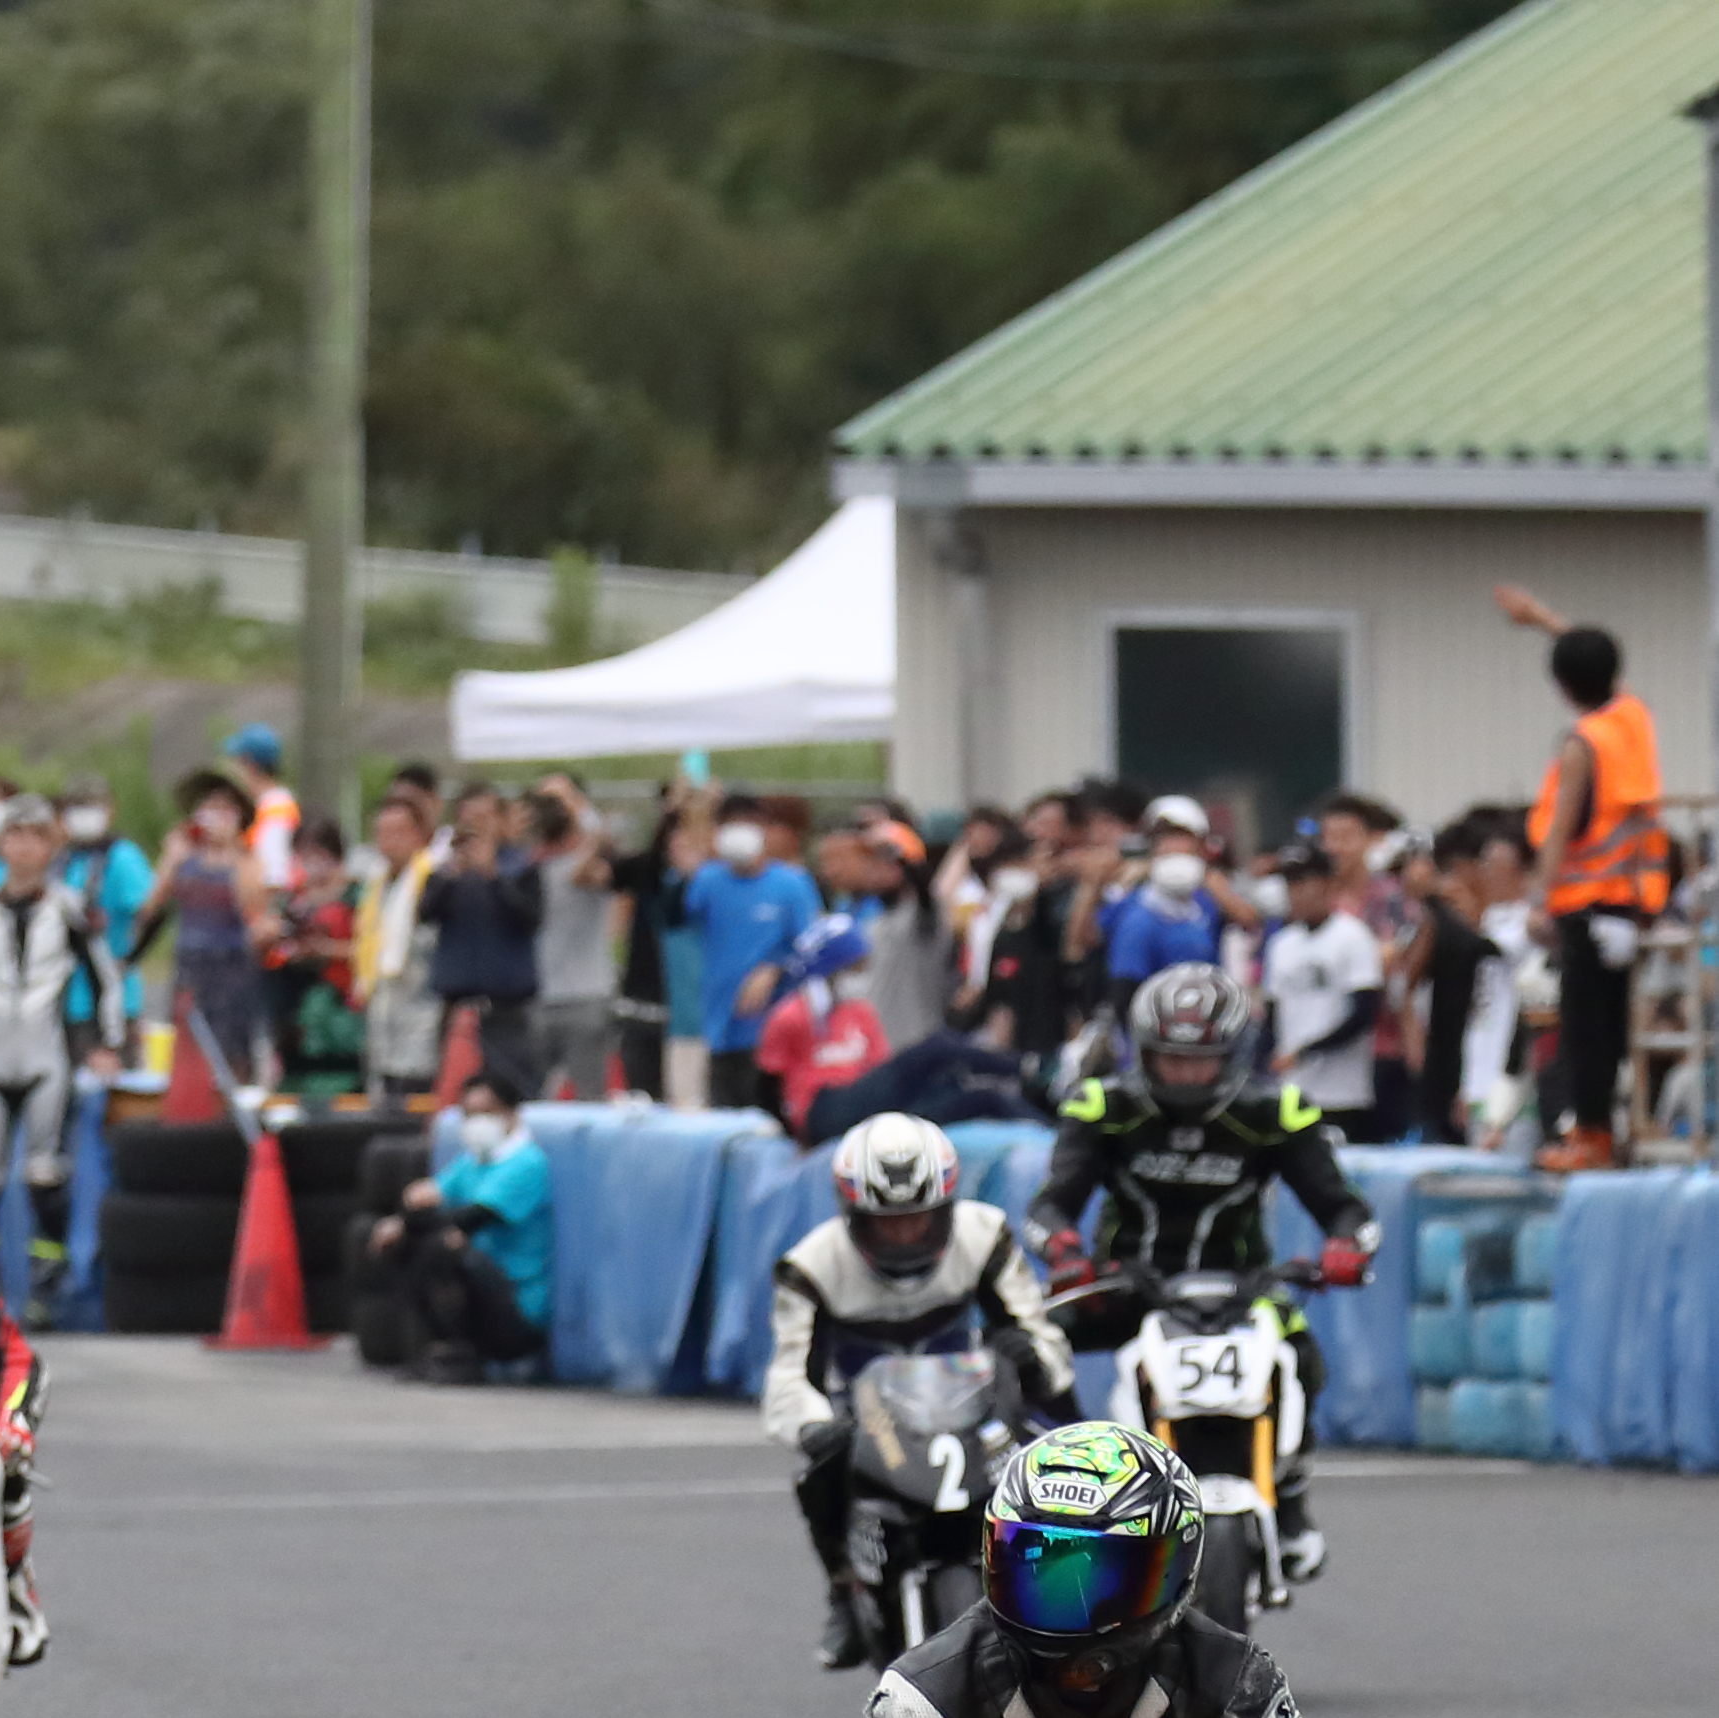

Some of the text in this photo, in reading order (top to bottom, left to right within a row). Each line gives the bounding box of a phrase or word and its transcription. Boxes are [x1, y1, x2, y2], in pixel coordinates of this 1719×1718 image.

[1178, 1344, 1243, 1391] 54
[927, 1433, 970, 1513] 2
[1039, 1482, 1097, 1505] SHOEI
